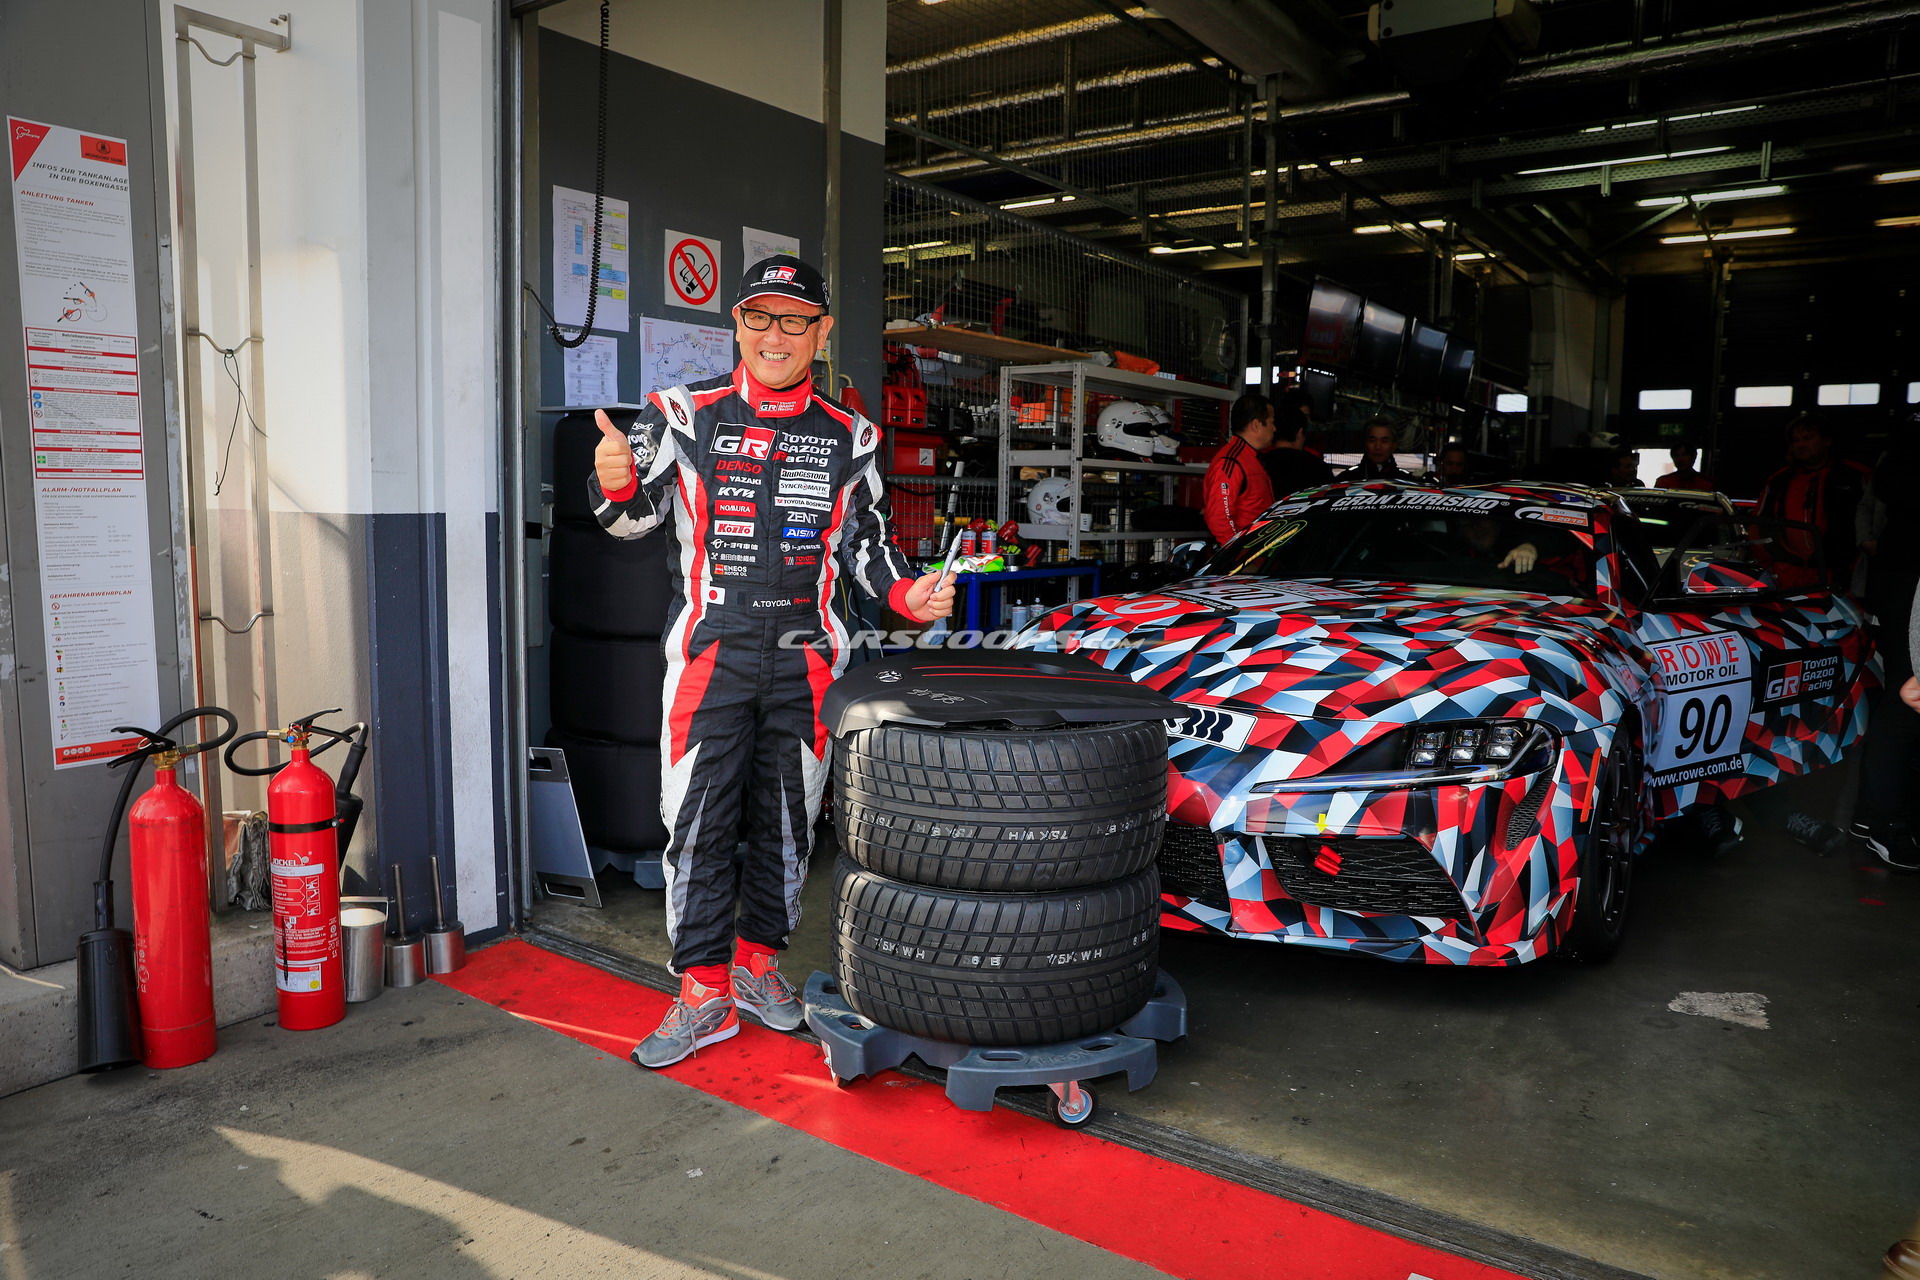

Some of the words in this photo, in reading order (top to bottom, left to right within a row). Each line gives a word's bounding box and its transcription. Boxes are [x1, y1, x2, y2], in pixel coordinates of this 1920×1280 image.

[32, 162, 58, 172] INFOS
[78, 170, 128, 185] TANKANLAGE
[78, 178, 128, 192] BOXENGASSE
[20, 190, 64, 202] ANLEITUNG
[66, 197, 95, 206] TANKEN
[763, 270, 792, 280] GR
[782, 432, 838, 446] TOYOTA
[713, 435, 769, 459] GR
[778, 442, 832, 455] GAZOO
[772, 452, 829, 467] Racing
[716, 460, 763, 474] DENSO
[729, 475, 762, 485] YAZAKI
[781, 470, 828, 480] BRIDGESTONE
[718, 487, 755, 498] KYB
[719, 504, 751, 513] NOMURA
[805, 501, 831, 509] BOSHOKU
[1331, 495, 1394, 508] GRAN
[1396, 495, 1500, 510] TURISMO
[1424, 505, 1490, 515] SIMULATOR
[787, 511, 818, 525] ZENT
[786, 528, 817, 538] AISIN
[723, 565, 747, 573] ENEOS
[49, 590, 132, 599] GEFAHRENABWEHRPLAN
[752, 599, 792, 608] A.TOYODA
[1656, 636, 1740, 673] ROWE
[1803, 655, 1839, 671] TOYOTA
[1664, 668, 1714, 687] MOTOR
[1718, 664, 1739, 677] OIL
[1802, 667, 1835, 682] GAZOO
[1766, 677, 1800, 699] GR
[1801, 679, 1833, 694] Racing
[1674, 694, 1733, 760] 90
